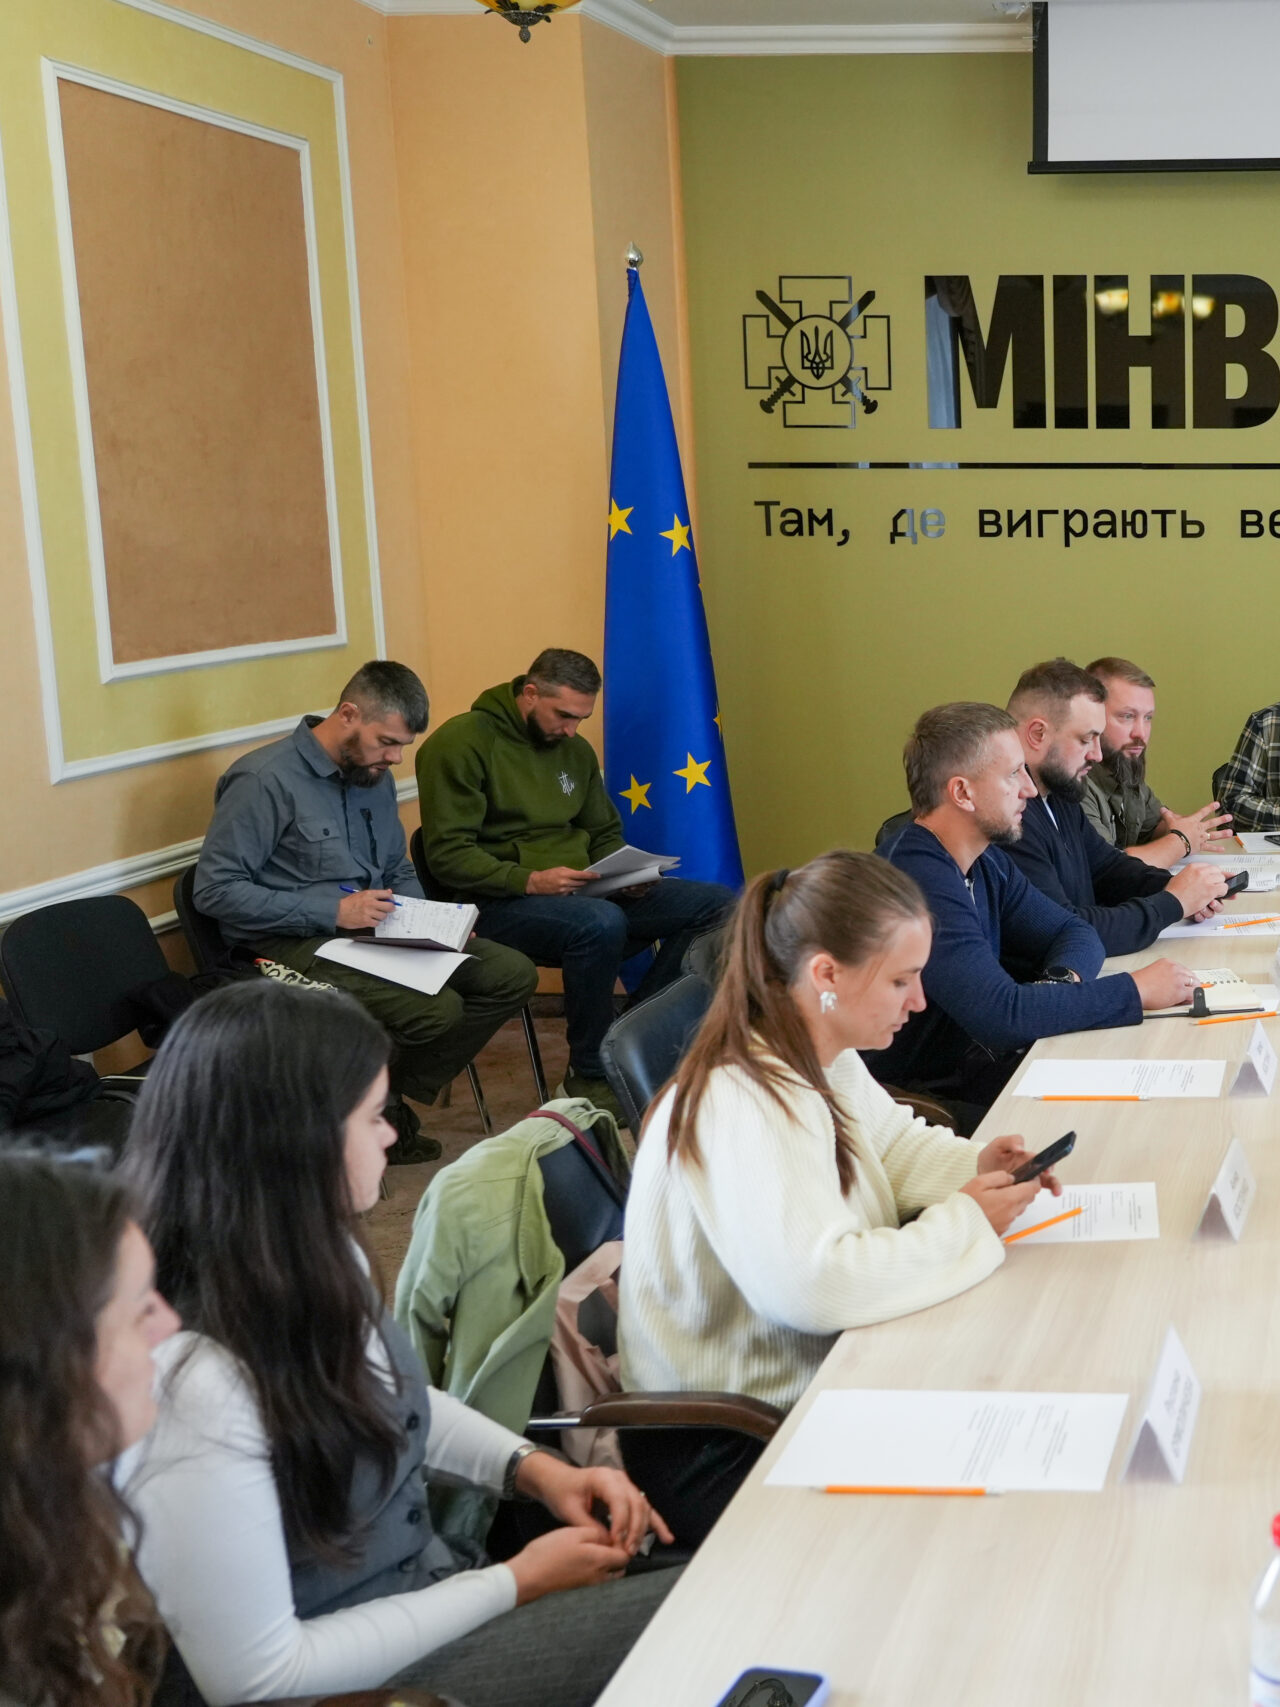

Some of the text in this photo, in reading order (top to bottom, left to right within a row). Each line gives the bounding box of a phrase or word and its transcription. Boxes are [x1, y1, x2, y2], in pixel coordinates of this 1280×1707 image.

[754, 500, 850, 546] Там,
[889, 507, 946, 544] де
[979, 508, 1206, 547] виграють
